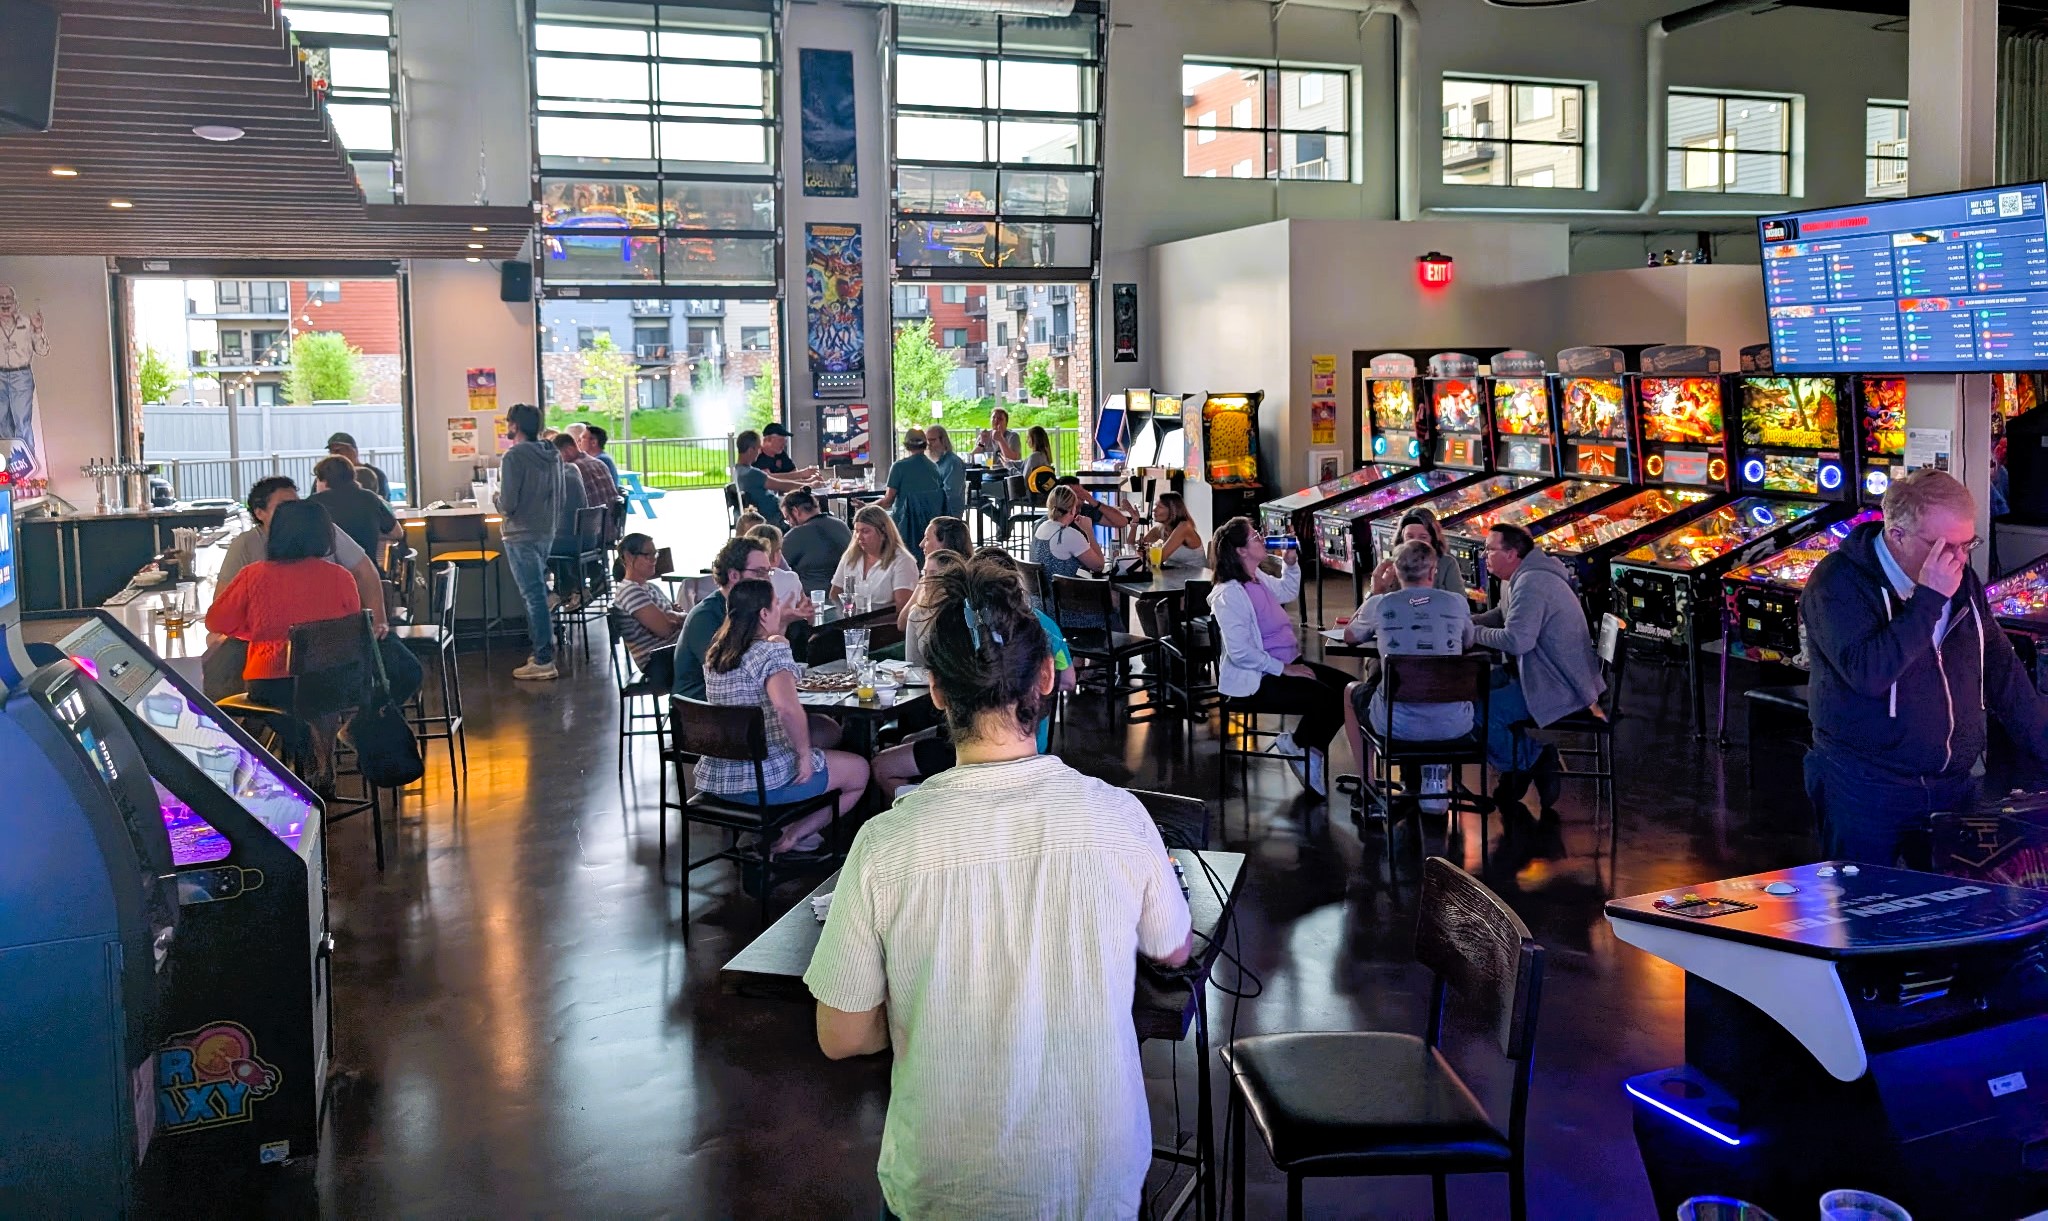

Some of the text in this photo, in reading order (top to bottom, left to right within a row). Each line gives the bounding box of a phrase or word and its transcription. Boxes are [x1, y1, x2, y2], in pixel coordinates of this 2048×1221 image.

[1428, 264, 1447, 281] EXIT
[1764, 429, 1822, 446] JURASSIC PARK
[1843, 885, 1992, 918] GOLDEN
[160, 1083, 249, 1124] AXY
